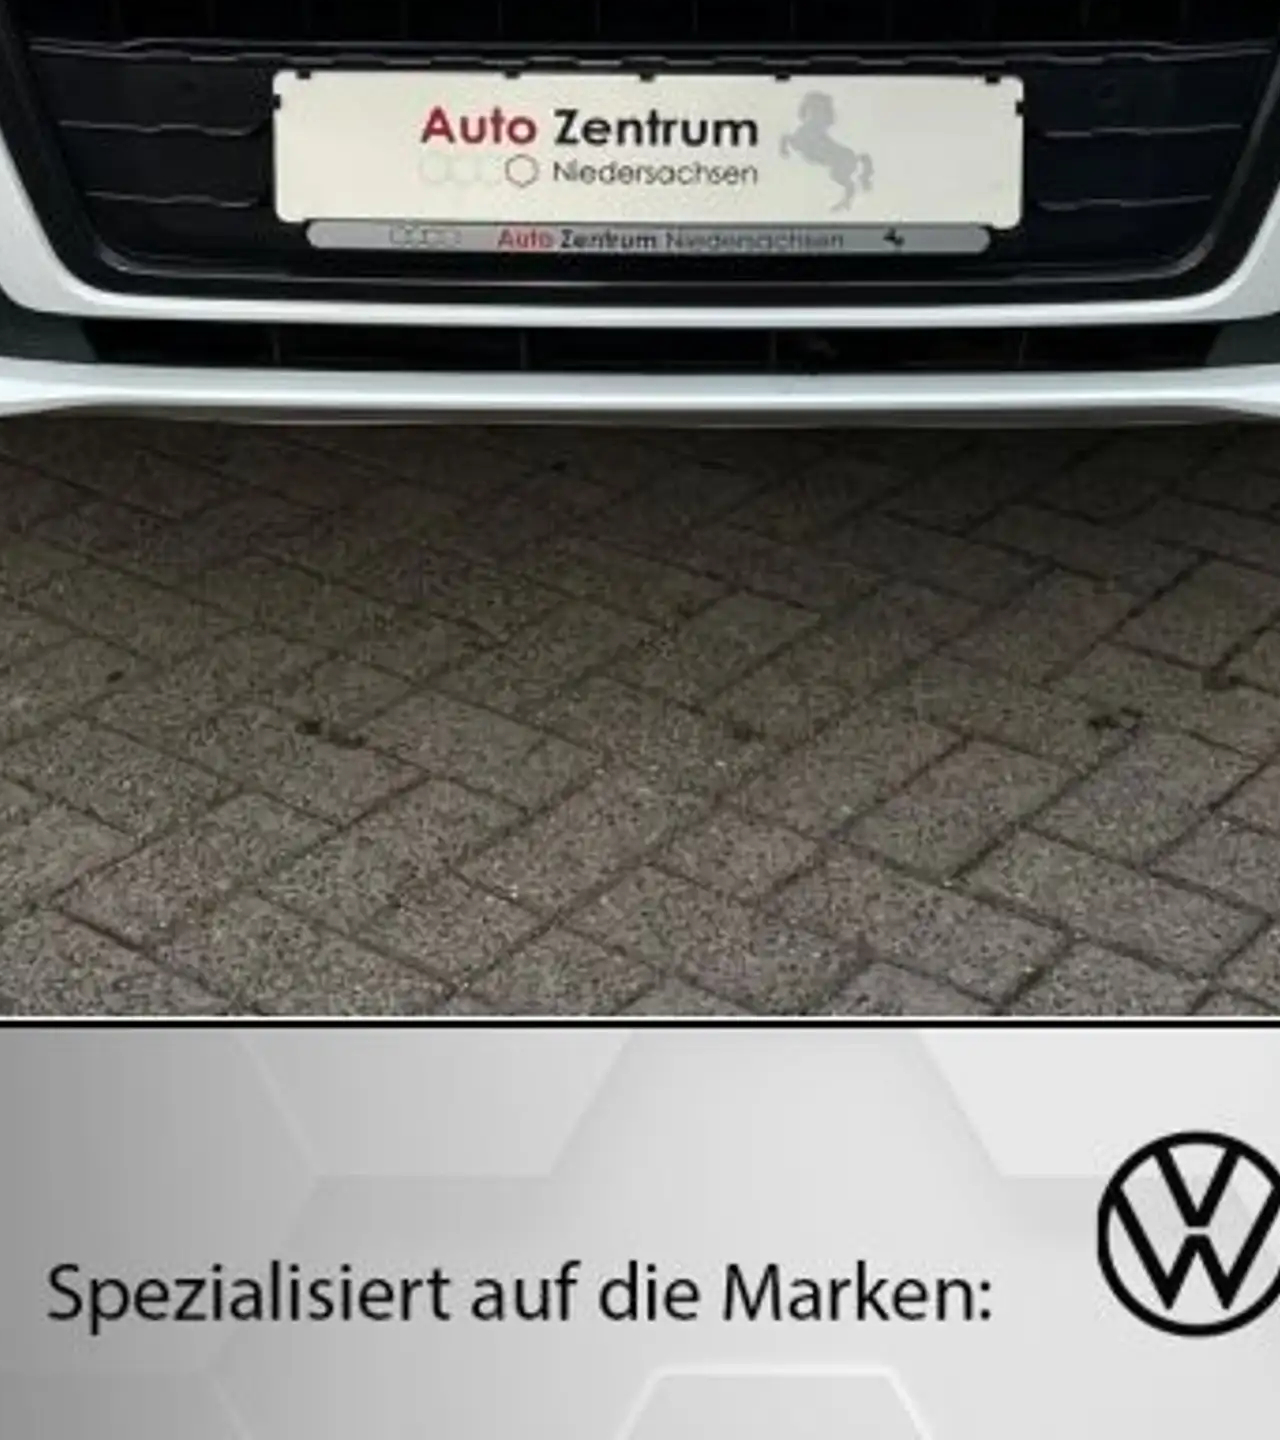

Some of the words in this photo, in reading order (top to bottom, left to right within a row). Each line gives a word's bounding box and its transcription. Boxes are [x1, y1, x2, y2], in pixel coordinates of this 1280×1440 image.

[421, 106, 537, 146] Auto
[553, 108, 758, 148] Zentrum
[553, 160, 758, 187] Niedersachsen
[497, 228, 552, 251] Auto
[560, 229, 658, 250] Zentrum
